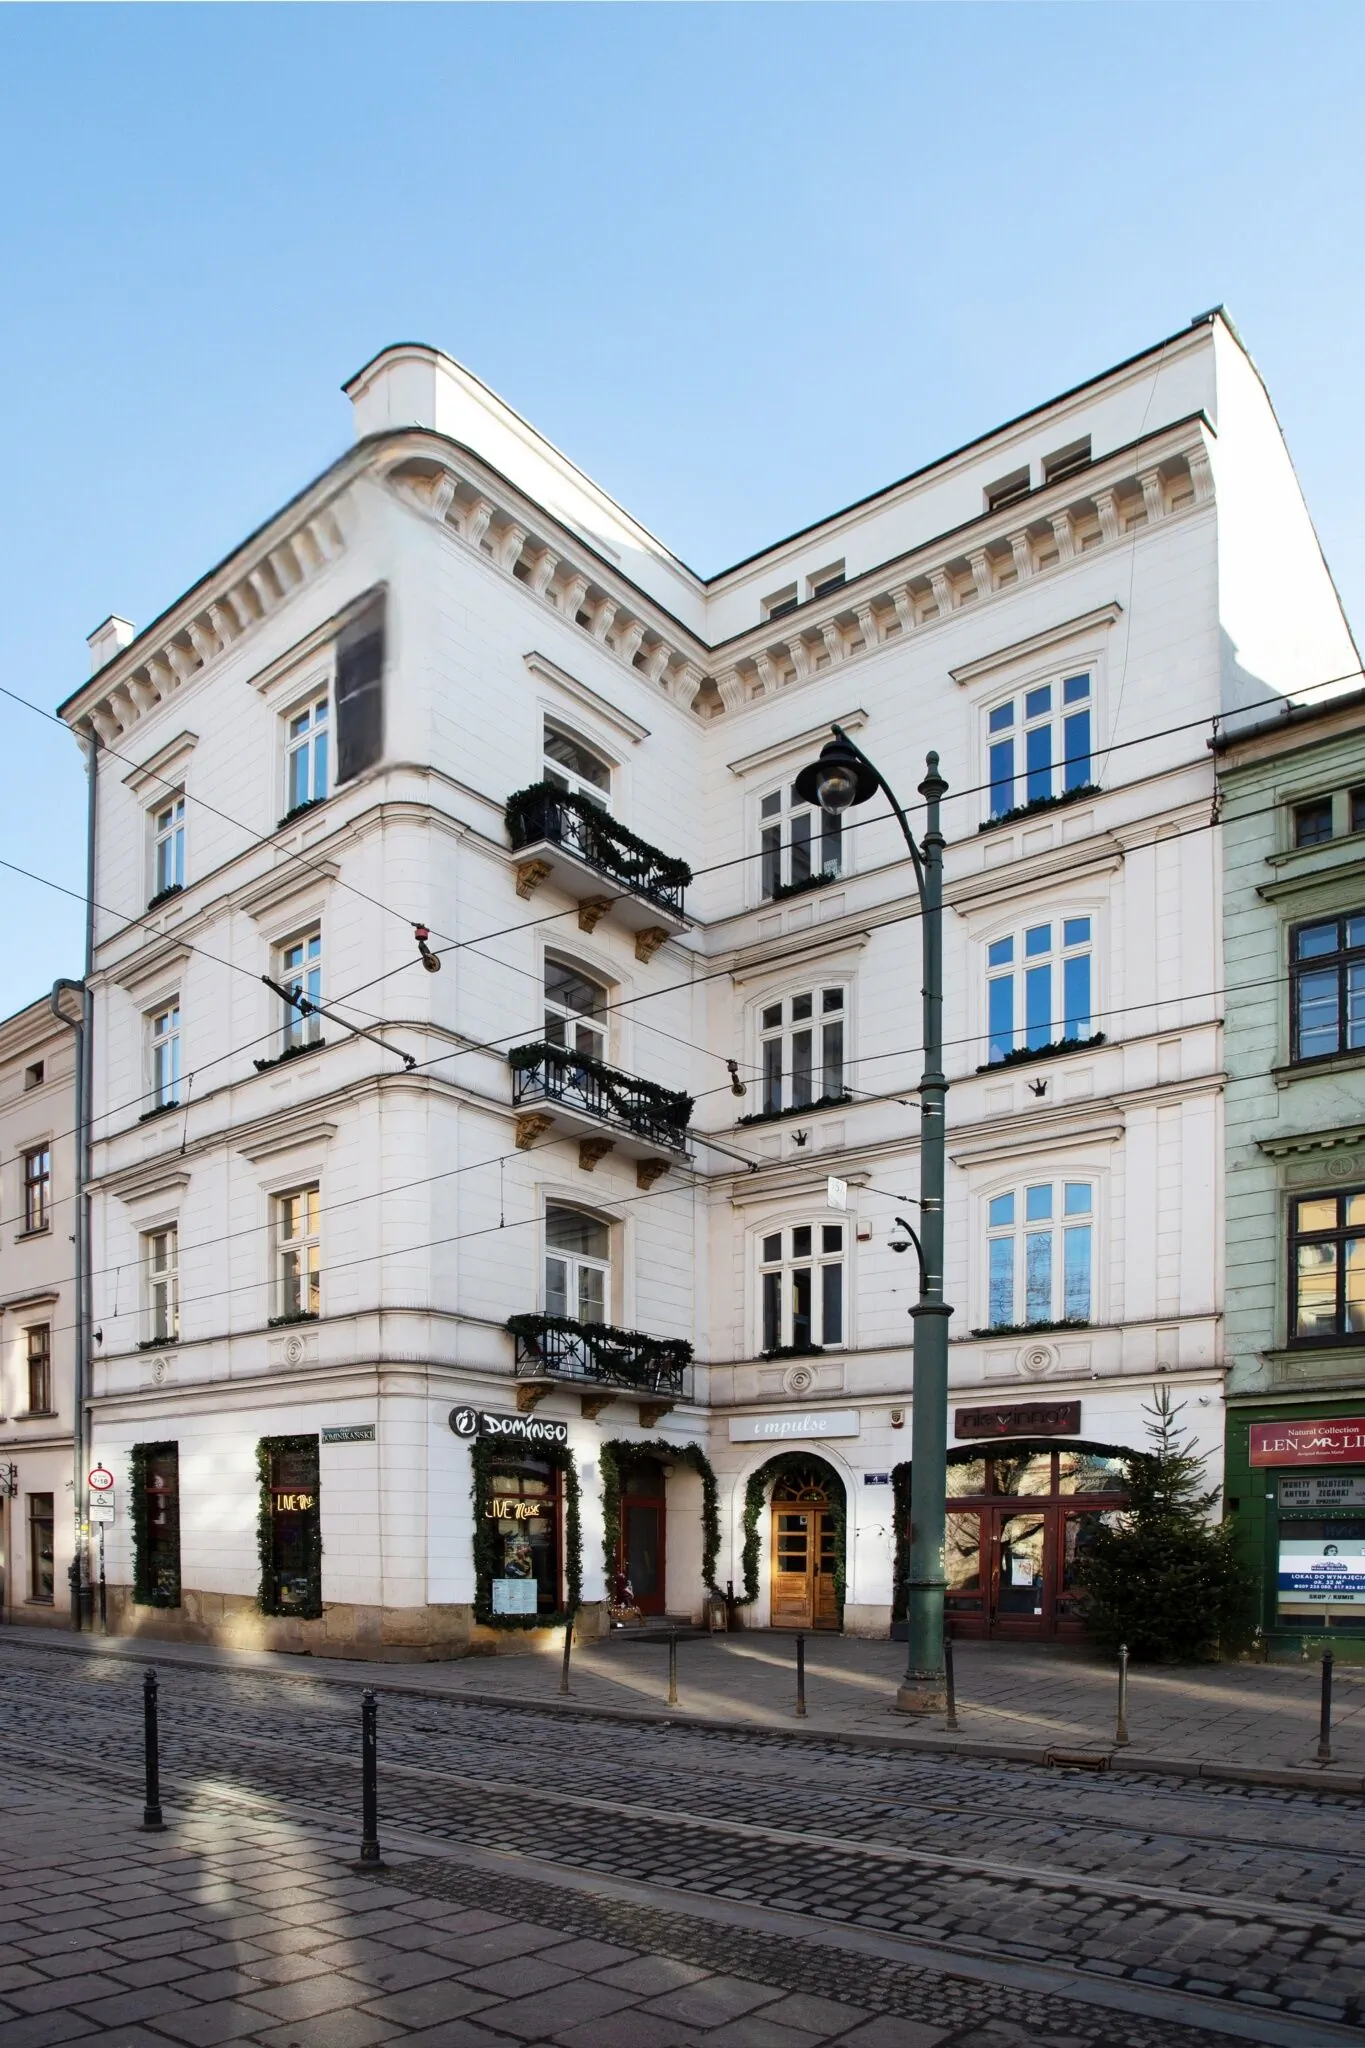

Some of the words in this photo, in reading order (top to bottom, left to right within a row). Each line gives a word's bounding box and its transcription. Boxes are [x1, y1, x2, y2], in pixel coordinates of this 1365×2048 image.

[754, 1415, 827, 1438] impulse
[1318, 1427, 1360, 1435] Collection
[1262, 1439, 1299, 1452] LEN
